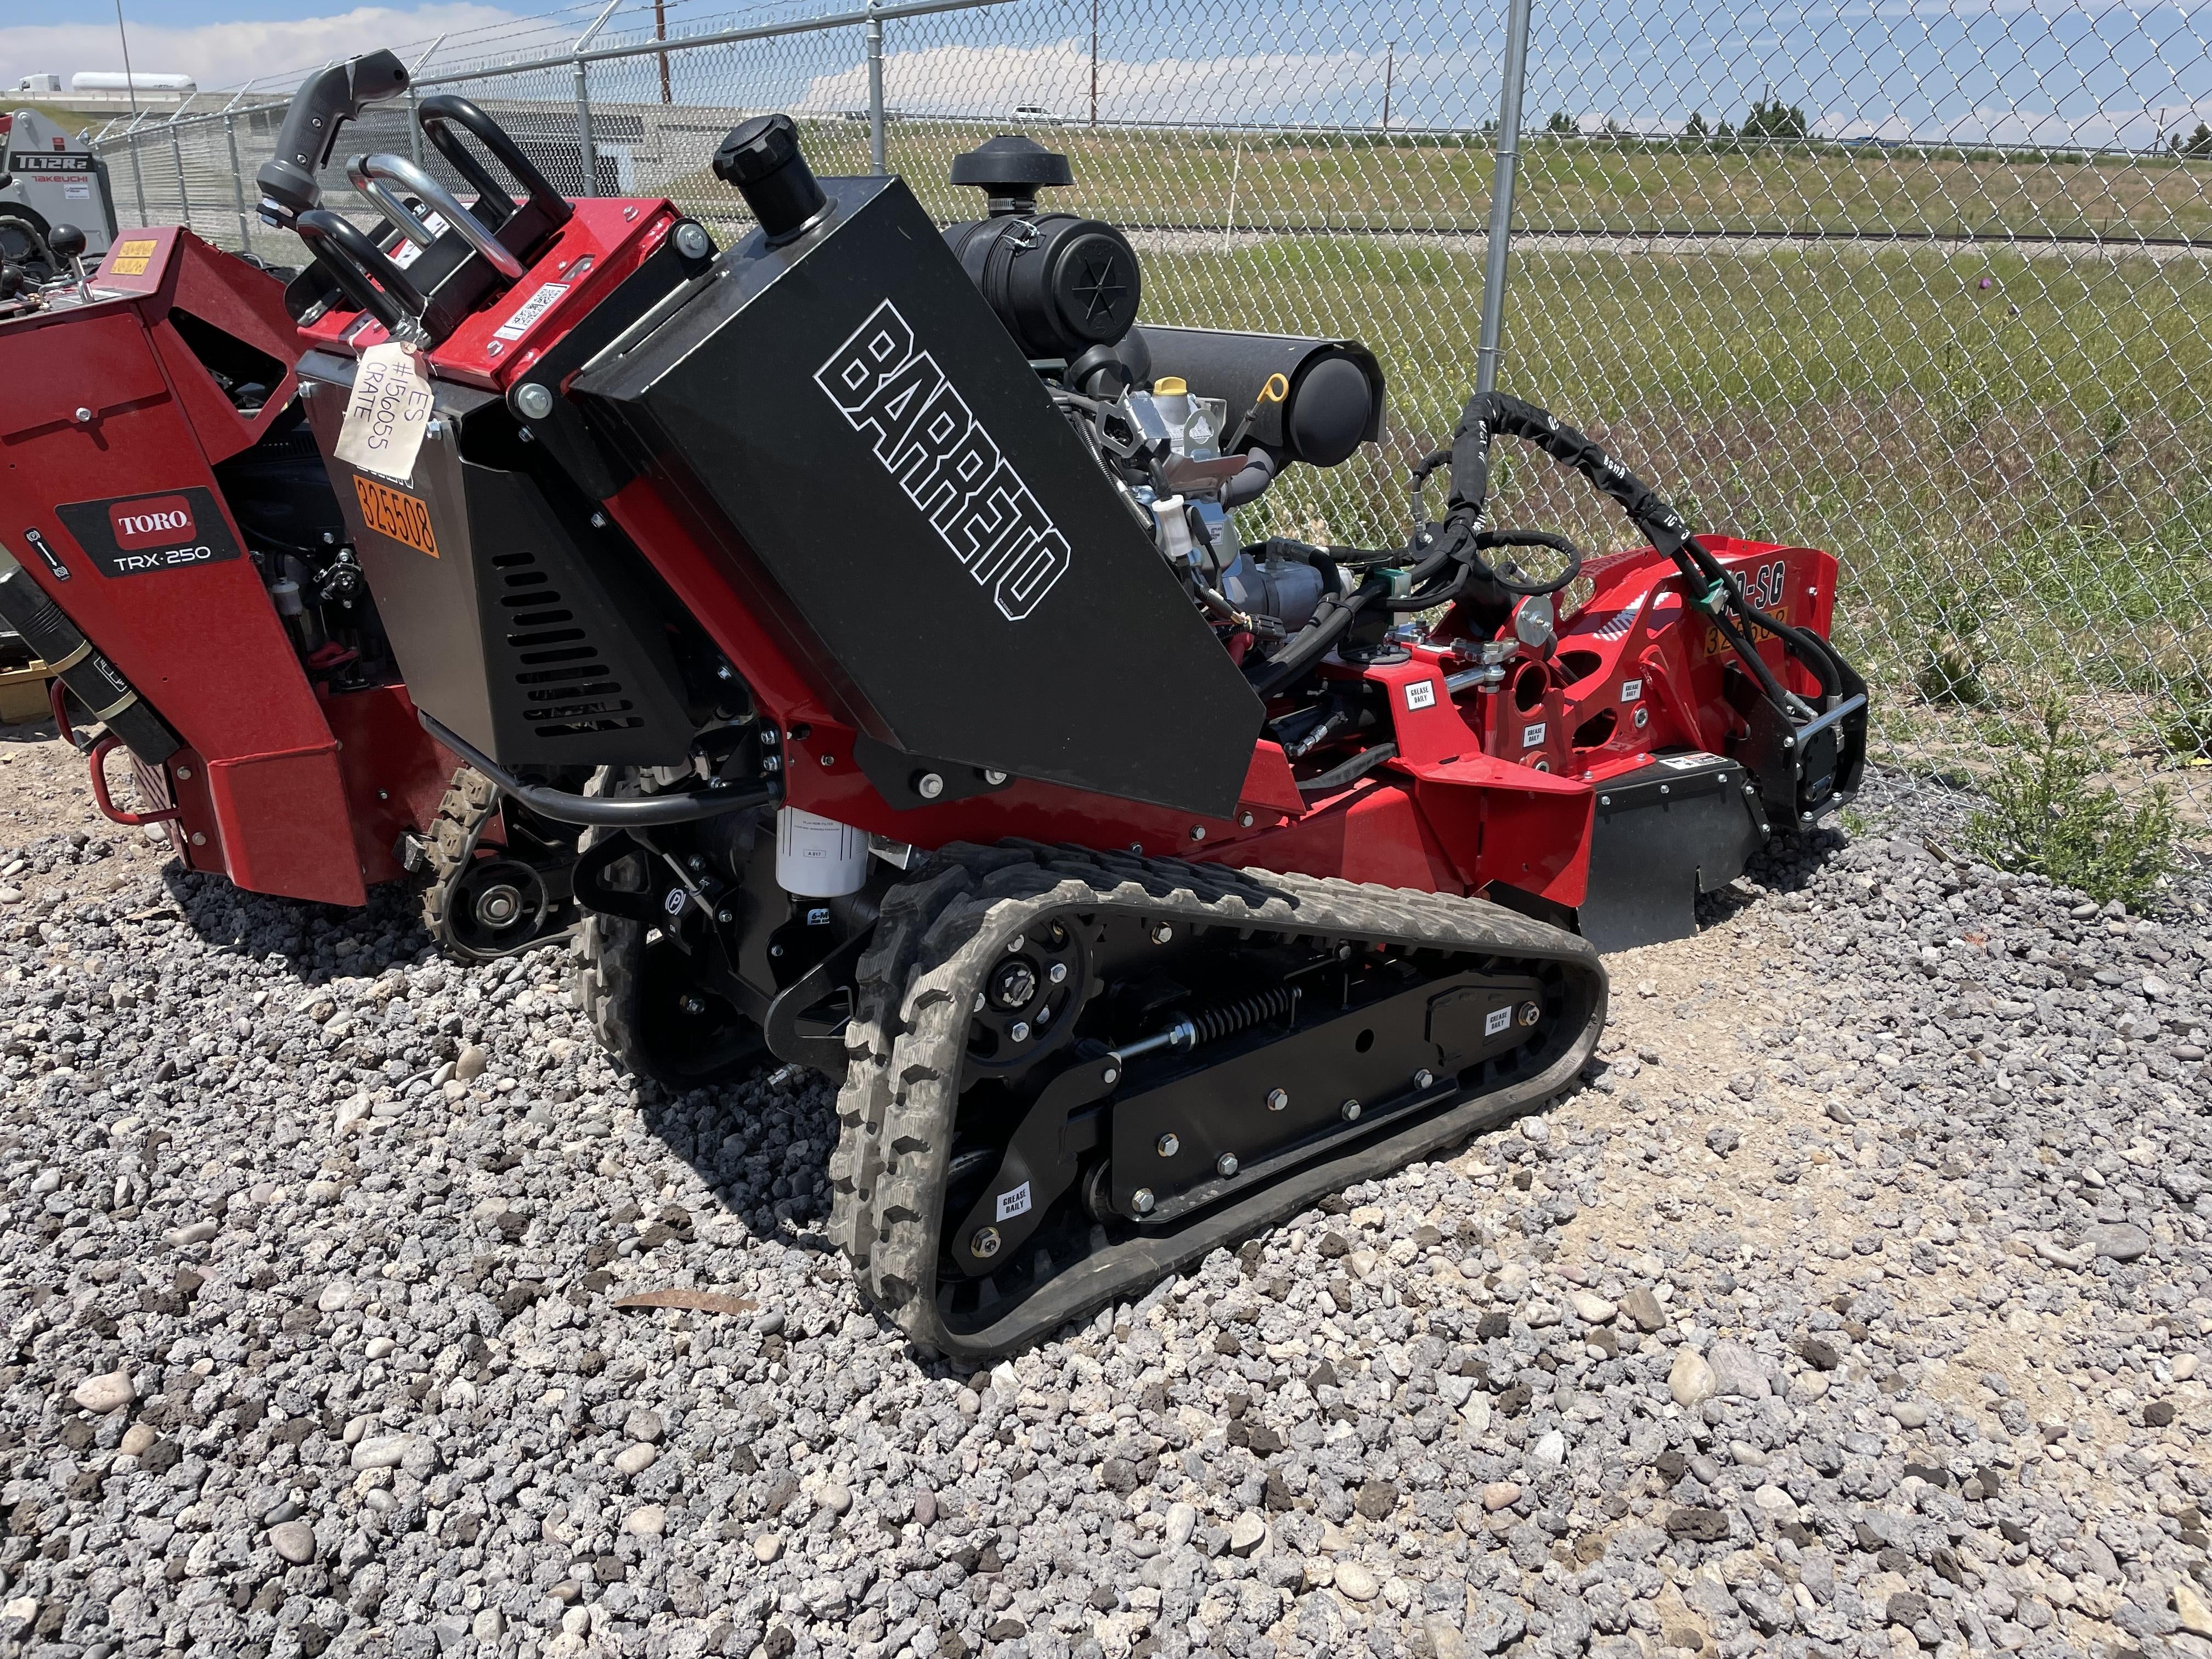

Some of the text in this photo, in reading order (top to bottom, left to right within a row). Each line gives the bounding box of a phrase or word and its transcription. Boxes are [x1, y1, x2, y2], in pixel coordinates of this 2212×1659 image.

[354, 362, 387, 422] CRATE
[368, 362, 413, 449] #156055
[404, 391, 429, 421] ES
[812, 297, 1071, 621] BARRETO
[118, 510, 187, 535] TORO
[358, 479, 434, 552] 325508
[1410, 686, 1429, 696] GREASE
[1414, 695, 1427, 703] DAILY
[1527, 727, 1542, 736] GREASE
[1490, 1011, 1508, 1023] GREASE
[1492, 1019, 1505, 1030] DAILY
[1003, 1189, 1026, 1206] GREASE
[1006, 1200, 1024, 1214] DAILY
